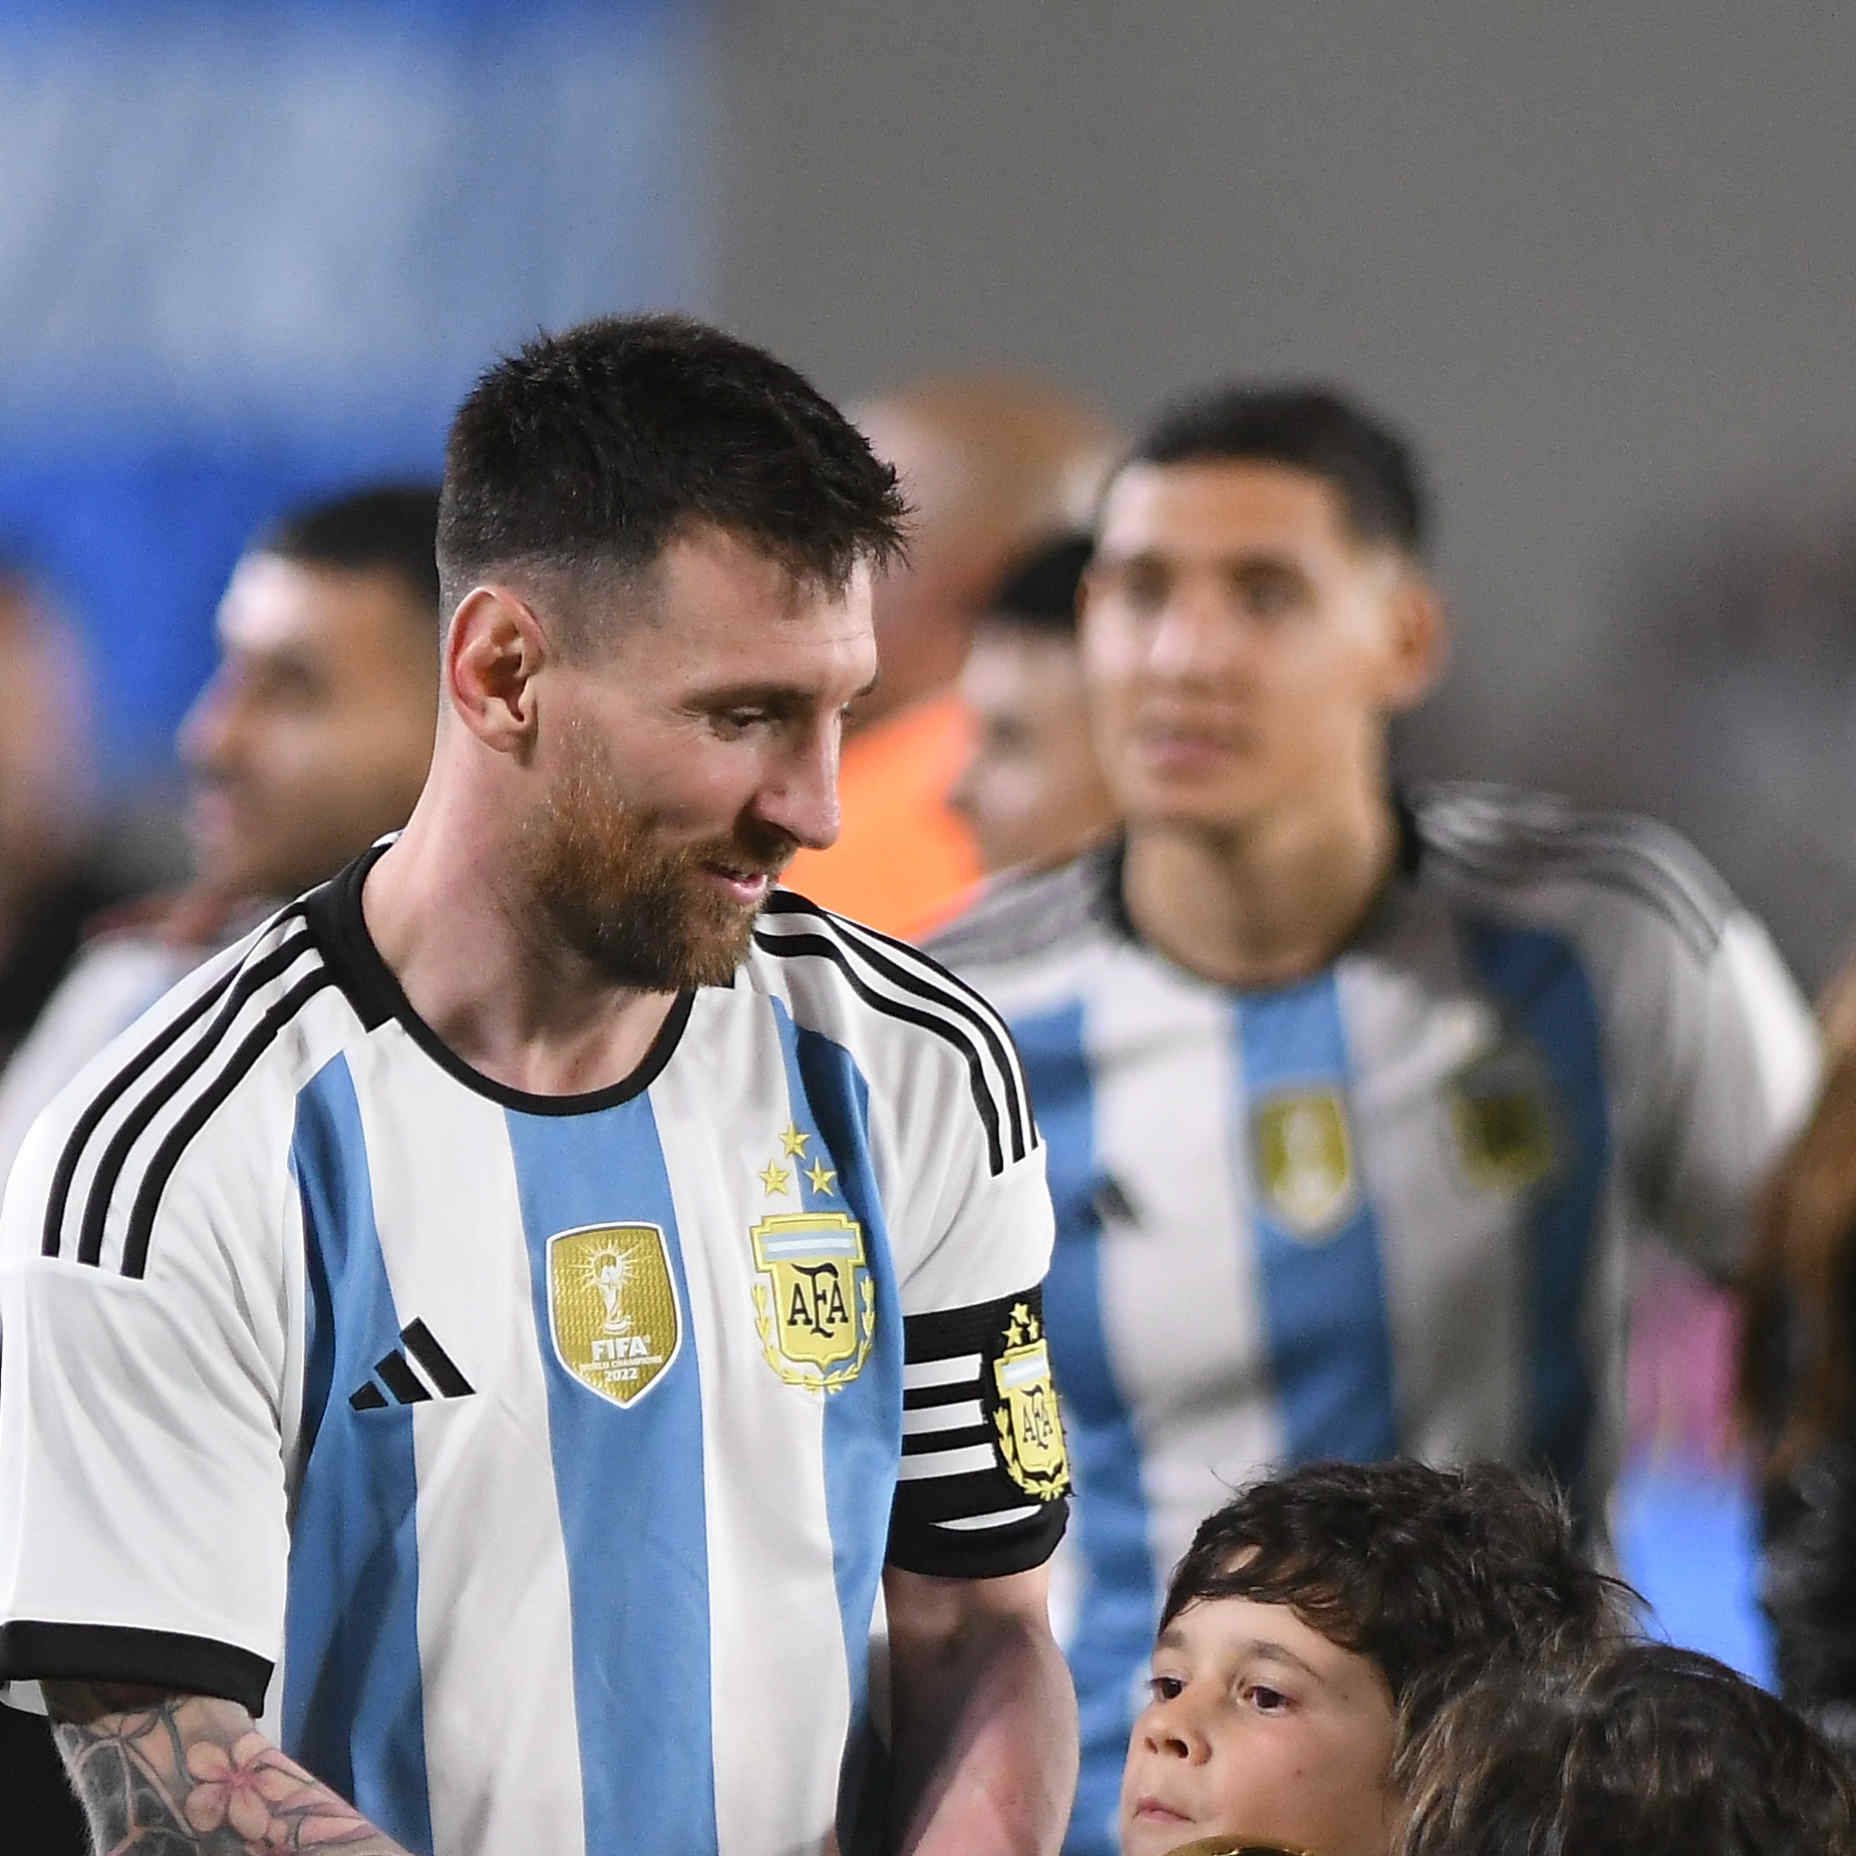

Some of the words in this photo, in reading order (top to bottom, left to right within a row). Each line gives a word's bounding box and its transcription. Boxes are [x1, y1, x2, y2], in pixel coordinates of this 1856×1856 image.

[786, 1262, 850, 1339] AFA
[591, 1336, 649, 1361] FIFA
[604, 1367, 640, 1383] 2022
[1020, 1384, 1054, 1450] AFA
